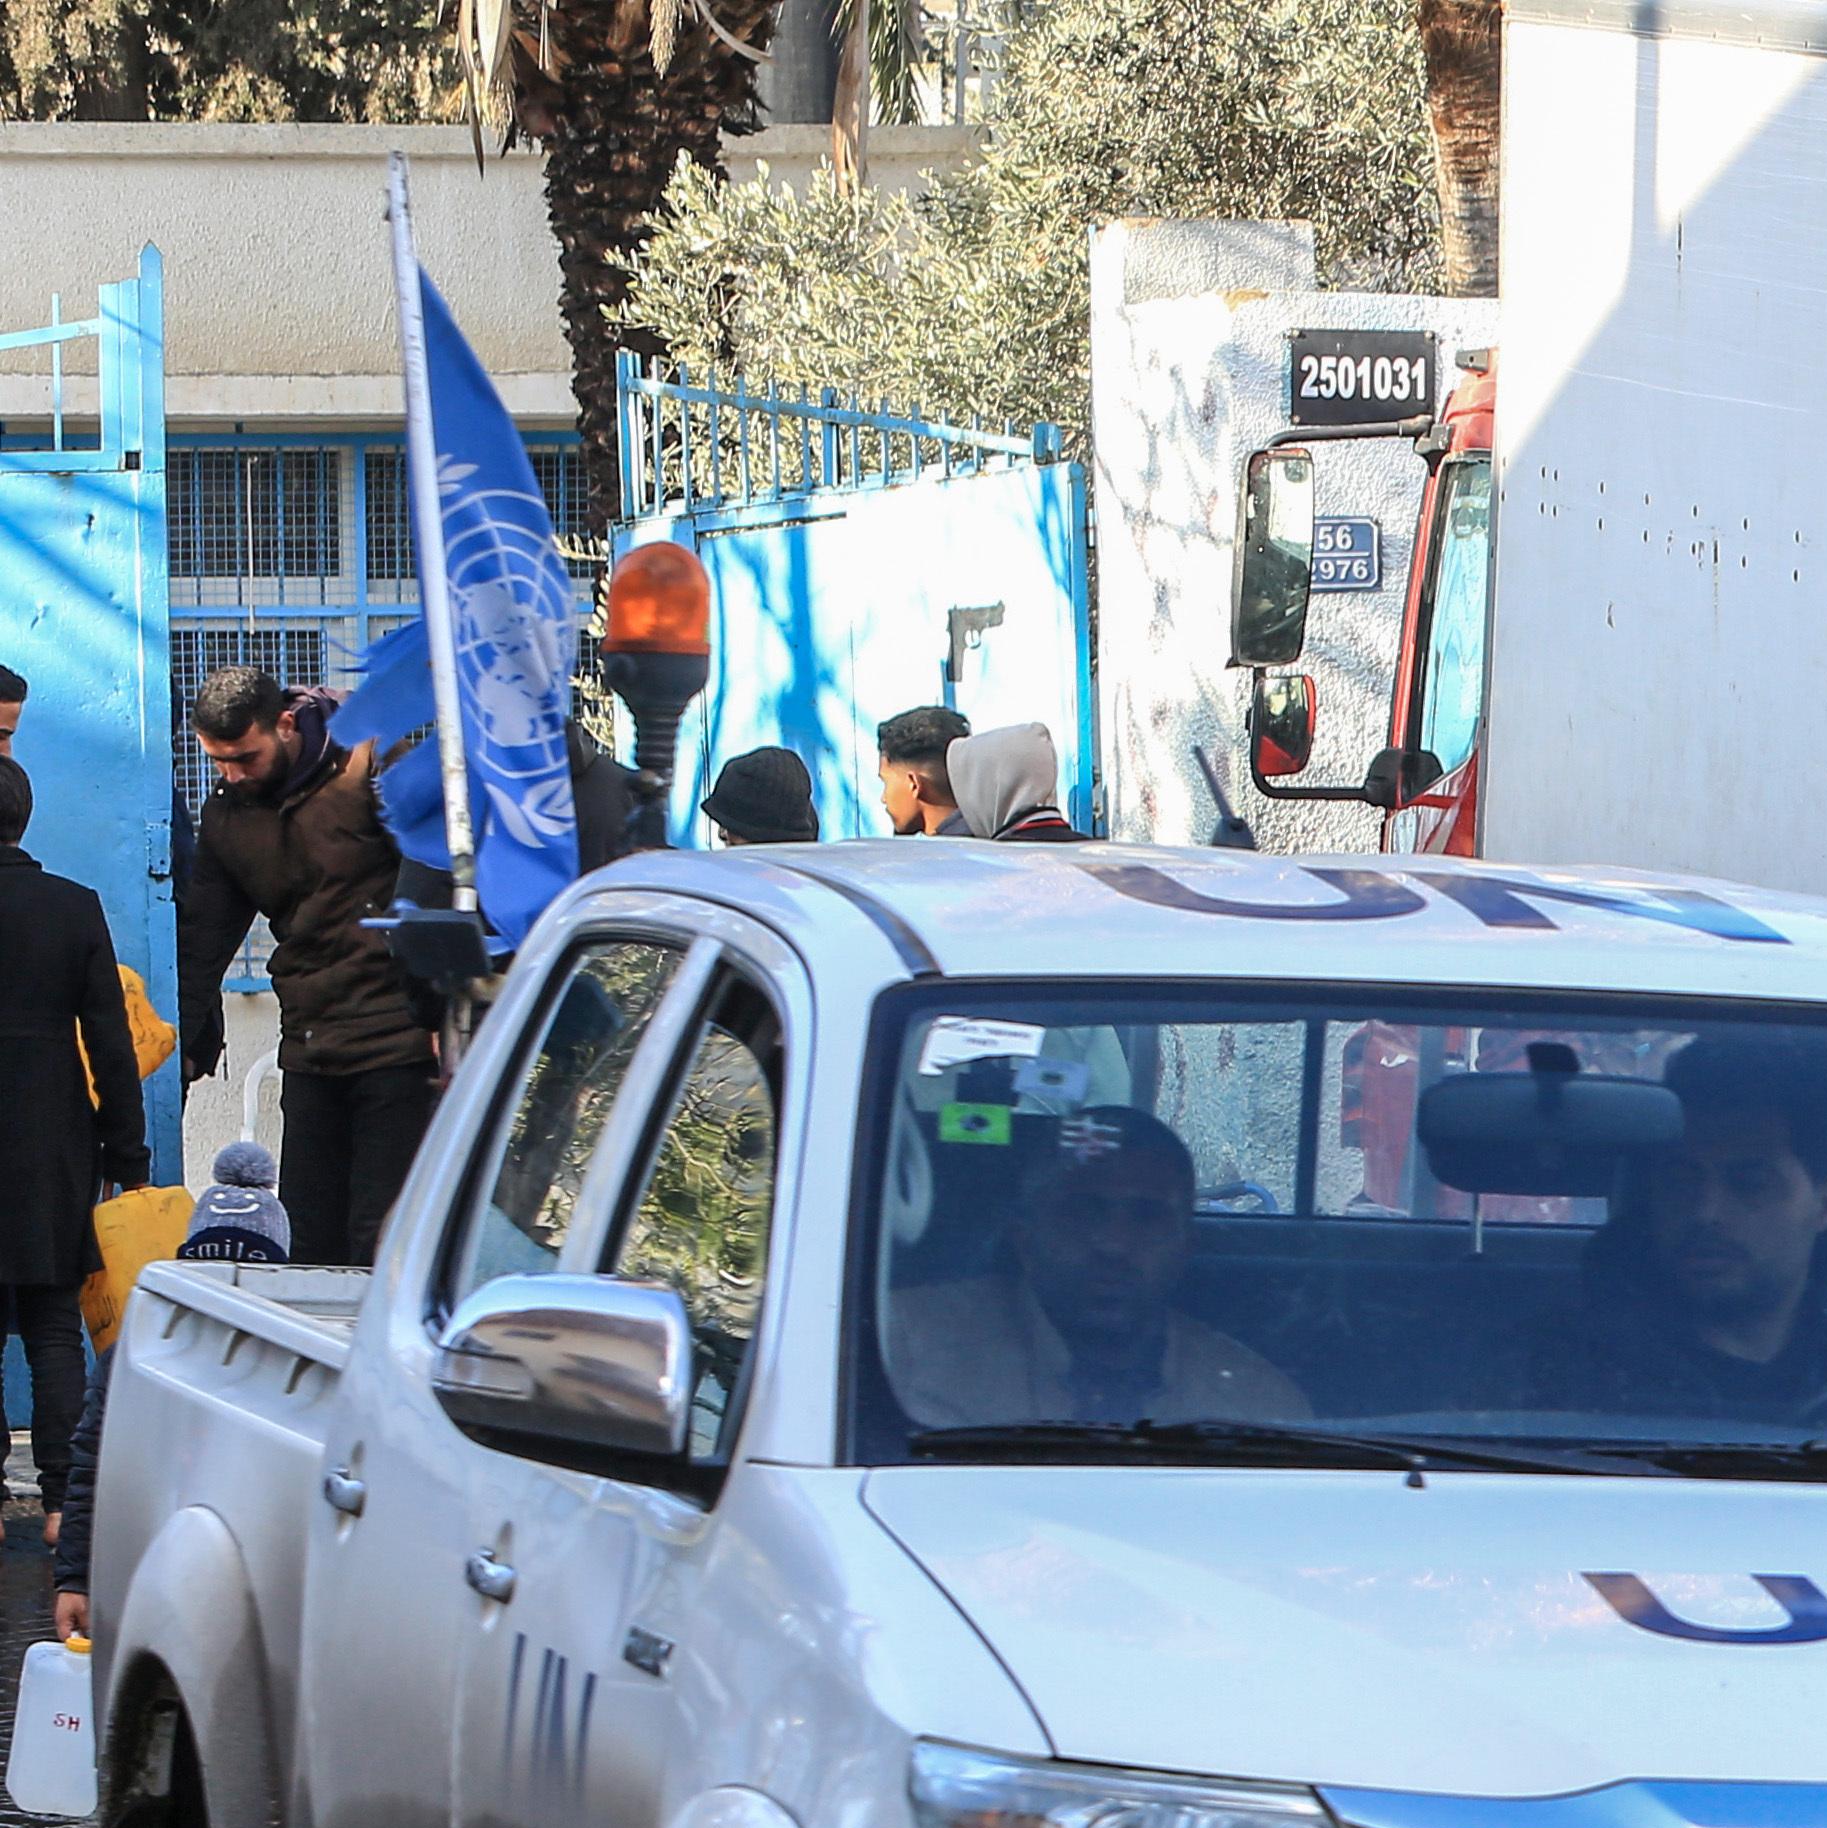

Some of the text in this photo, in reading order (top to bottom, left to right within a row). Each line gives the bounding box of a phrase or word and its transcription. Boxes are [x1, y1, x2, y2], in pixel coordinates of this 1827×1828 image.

[1300, 356, 1427, 400] 2501031
[1318, 524, 1353, 551] 56
[1072, 862, 1795, 945] UN
[185, 1239, 268, 1261] smile
